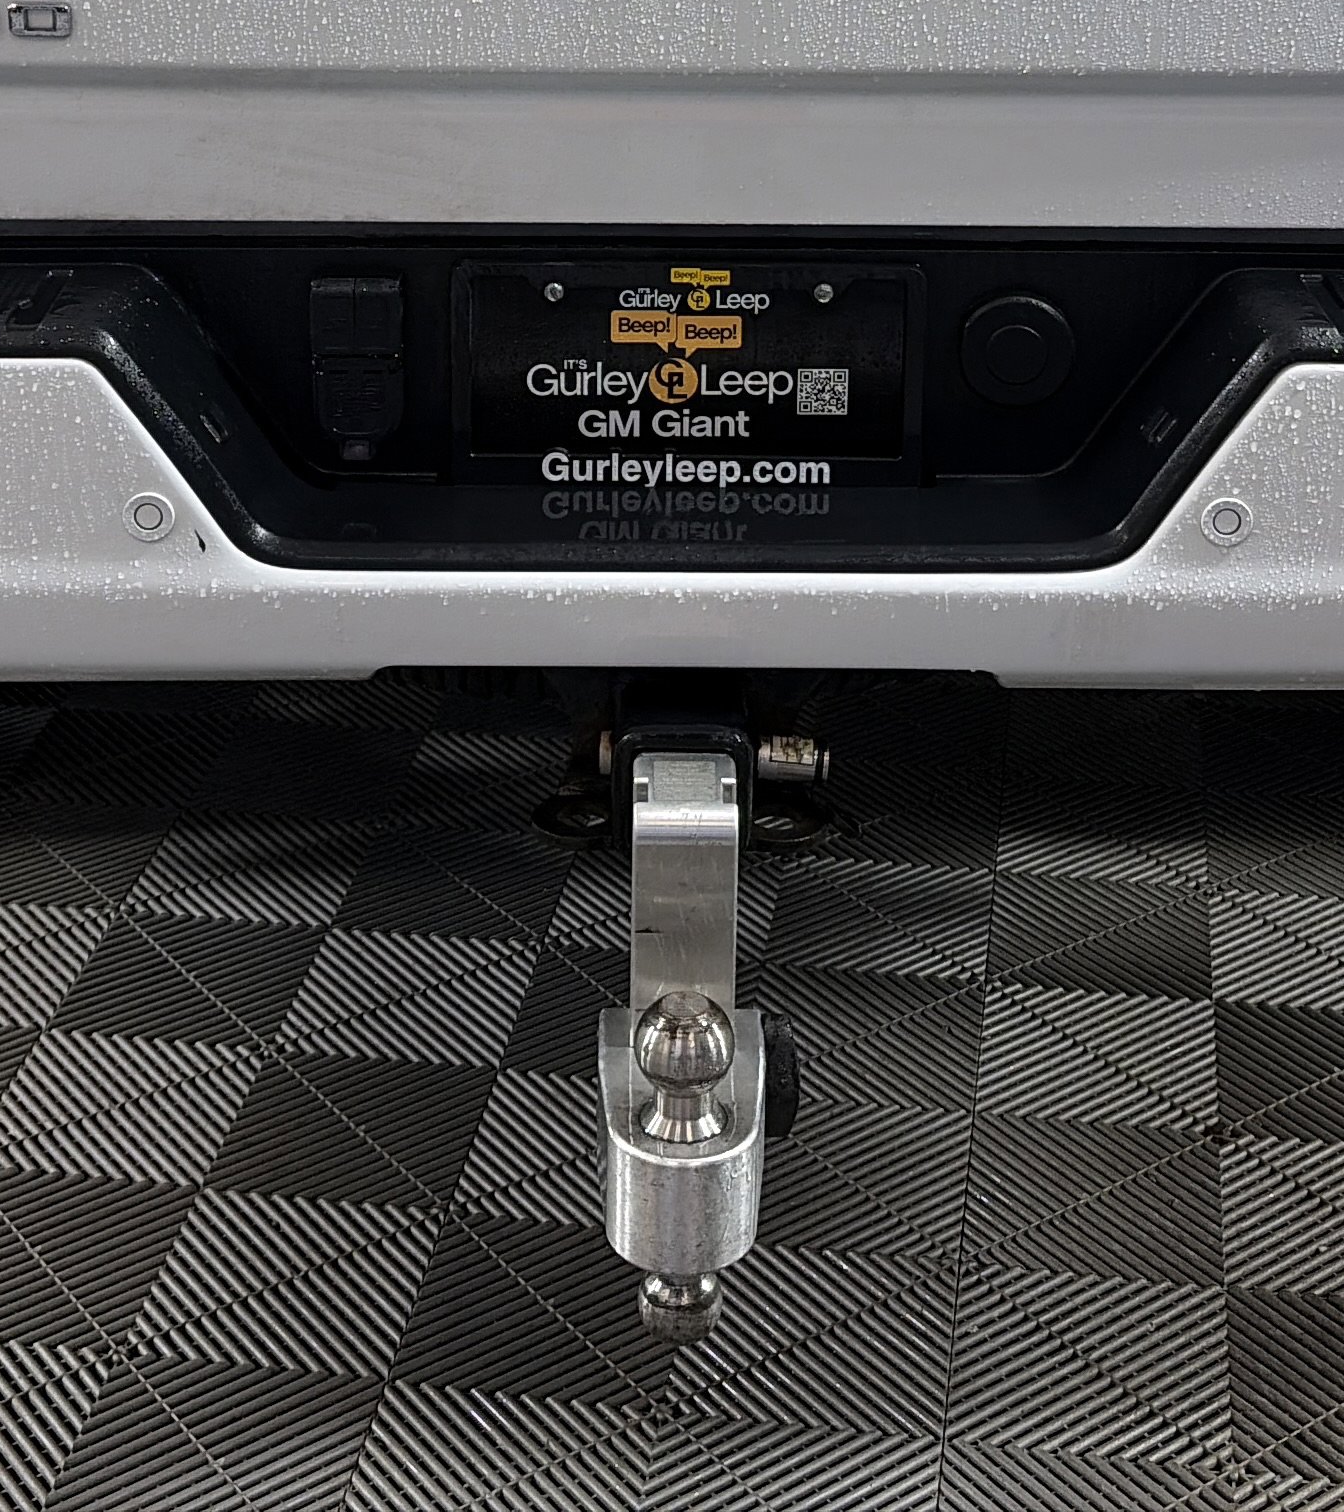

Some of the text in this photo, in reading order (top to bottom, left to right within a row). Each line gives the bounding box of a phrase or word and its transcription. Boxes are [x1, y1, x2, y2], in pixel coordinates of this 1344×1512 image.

[673, 270, 698, 280] Beep!
[703, 274, 728, 283] Beep!
[618, 289, 682, 312] Gurley
[715, 289, 770, 314] Leep
[617, 317, 671, 338] Beep!
[684, 324, 737, 344] Beep!
[563, 359, 588, 370] IT'S
[526, 361, 649, 405] Gurley
[700, 363, 794, 405] Leep
[577, 408, 751, 438] GM Giant
[541, 451, 831, 488] Gurleyleep.com
